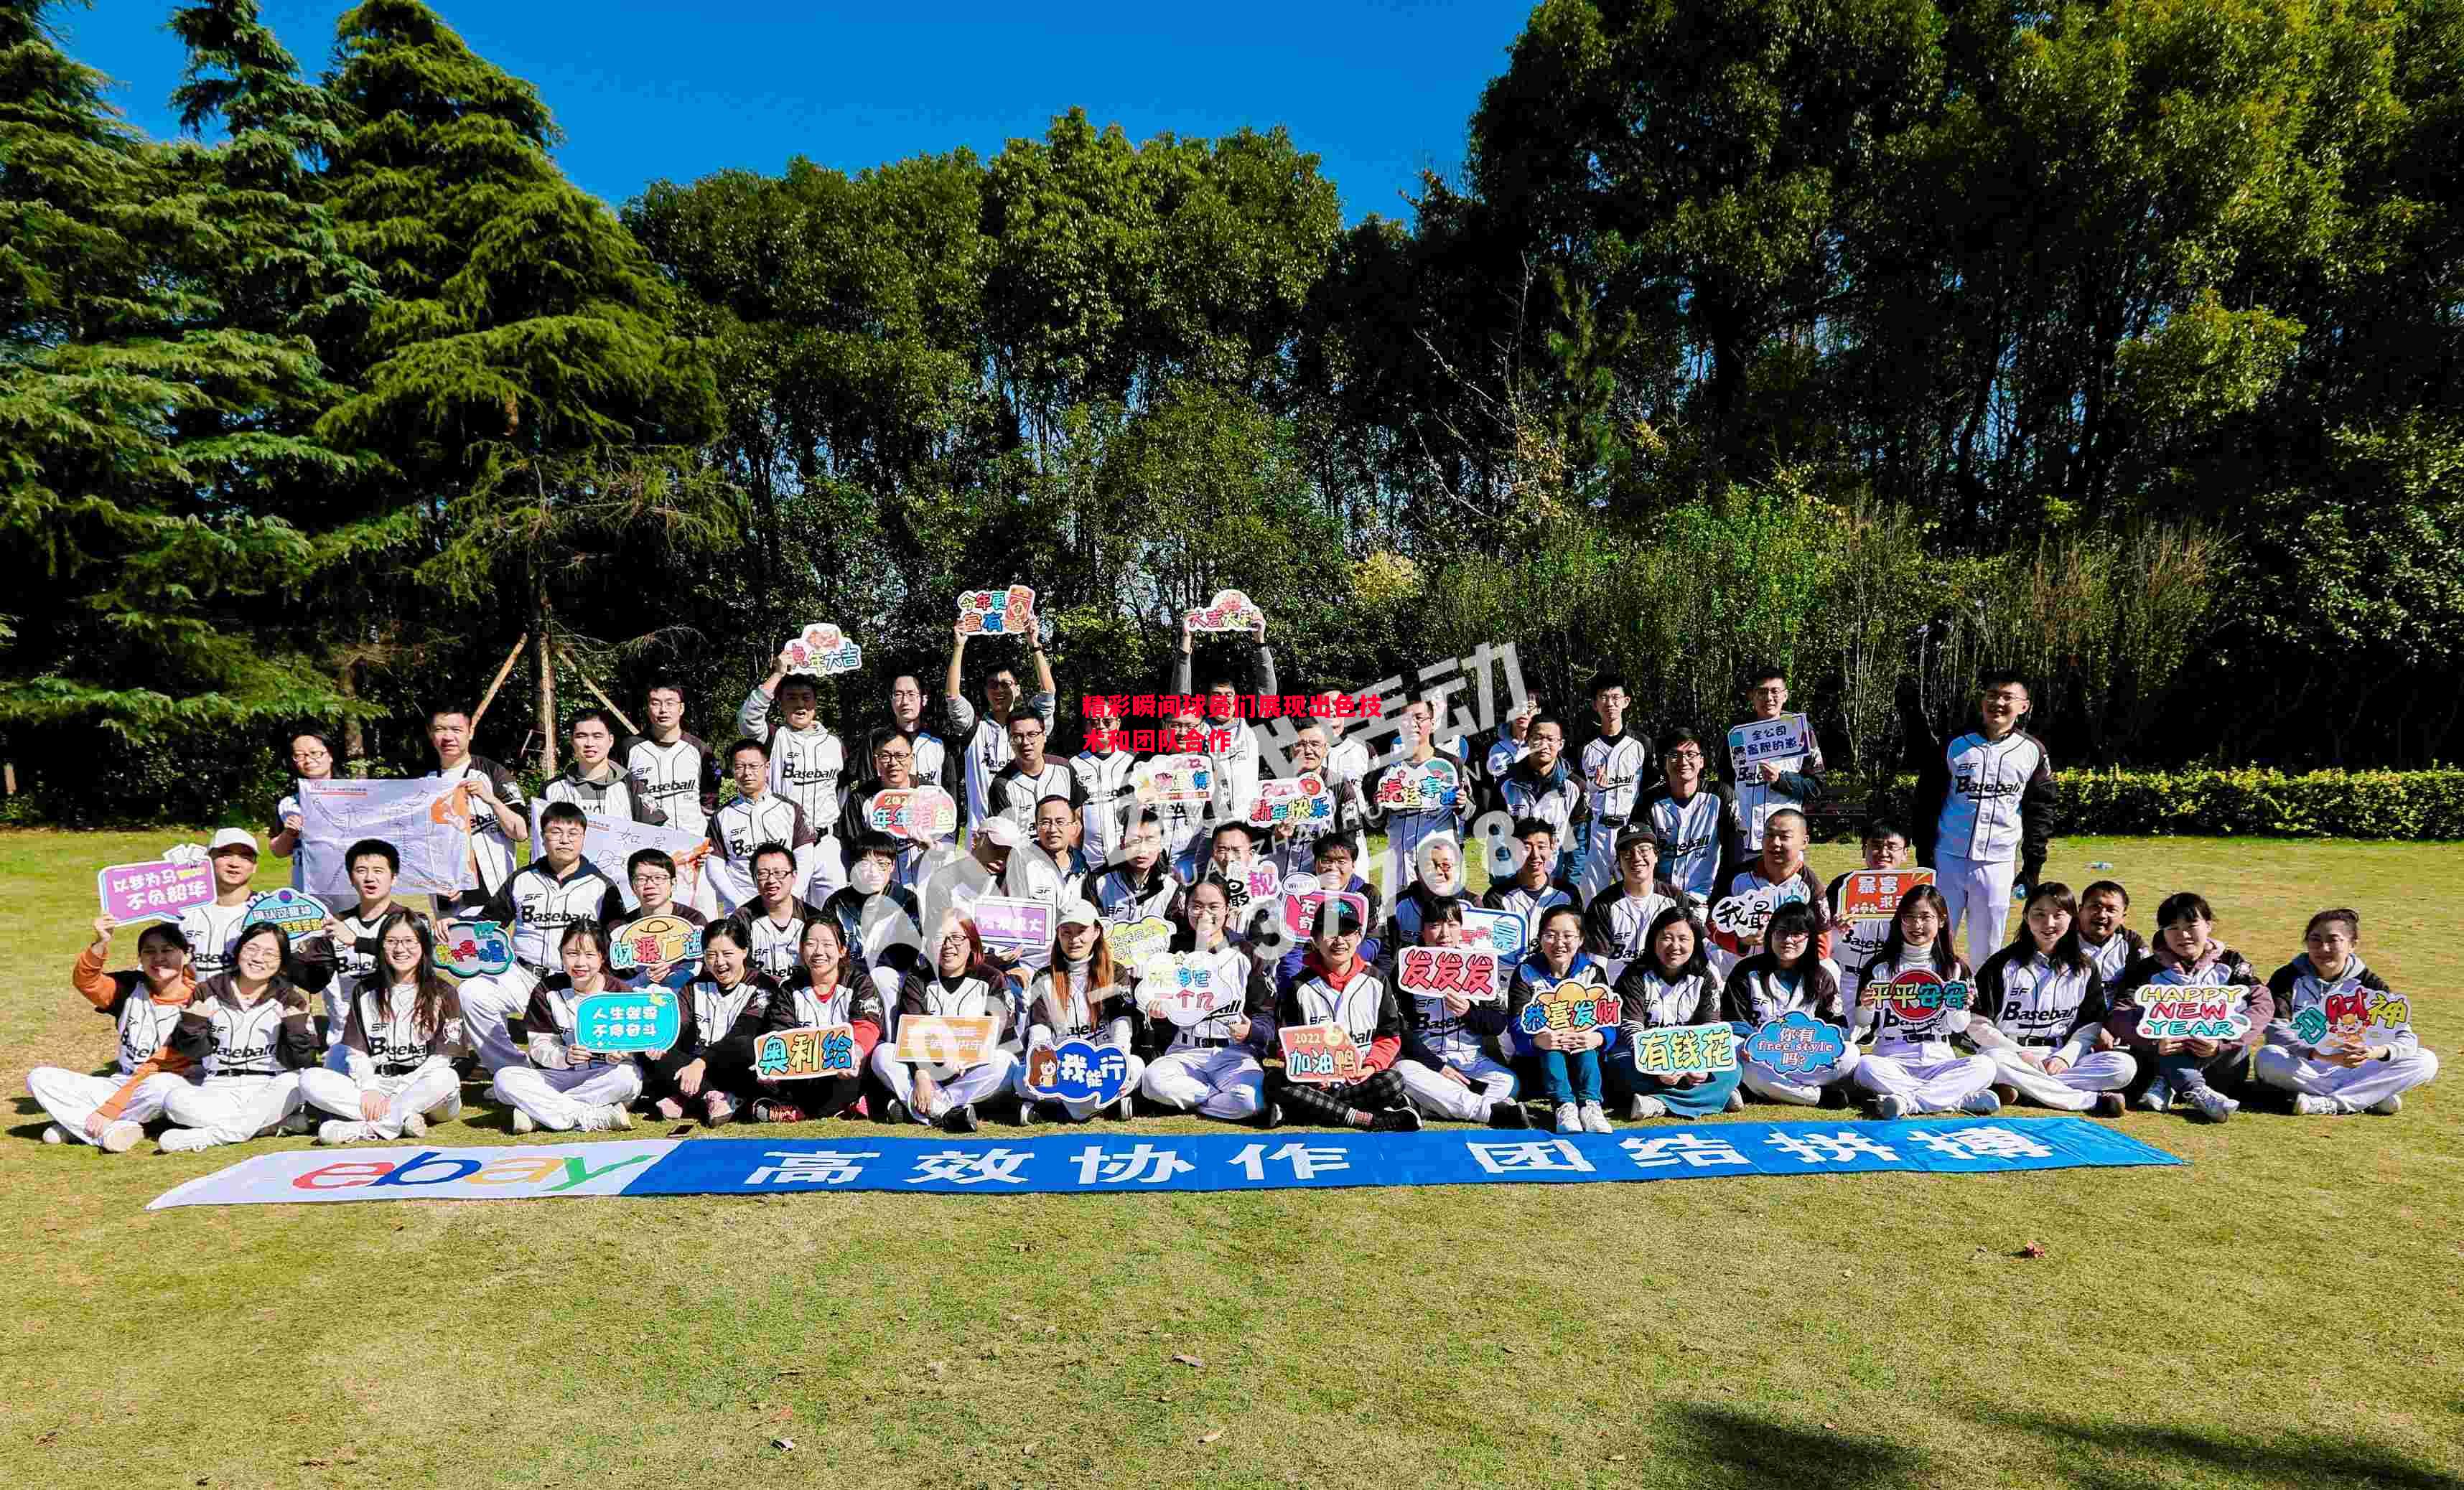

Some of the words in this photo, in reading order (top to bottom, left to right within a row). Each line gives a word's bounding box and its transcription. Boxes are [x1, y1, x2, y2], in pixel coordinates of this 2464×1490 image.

[964, 612, 1003, 632] 富有
[1752, 726, 1786, 741] 全公司
[781, 760, 838, 779] Baseball
[1958, 762, 1978, 771] SF
[1251, 796, 1330, 823] 新年快乐
[729, 826, 748, 835] SF
[113, 869, 177, 893] 以梦为马
[1858, 876, 1898, 894] 暴富
[523, 892, 543, 901] SF
[1401, 949, 1495, 995] 发发发
[1872, 982, 1968, 1011] 平平安安
[2010, 988, 2030, 997] SF
[2141, 987, 2241, 1003] HAPPY
[1523, 998, 1620, 1031] 恭喜发财
[2150, 1003, 2228, 1020] NEW
[1294, 1032, 1322, 1044] 2022
[2147, 1020, 2236, 1036] YEAR
[758, 1032, 852, 1074] 奥利给
[1639, 1031, 1733, 1071] 有钱花
[1061, 1051, 1125, 1088] 我能行
[1289, 1047, 1355, 1077] 加油鸭
[744, 1143, 1351, 1185] 高效协作
[1466, 1126, 2055, 1175] 团结拼搏
[292, 1151, 659, 1192] ebay
